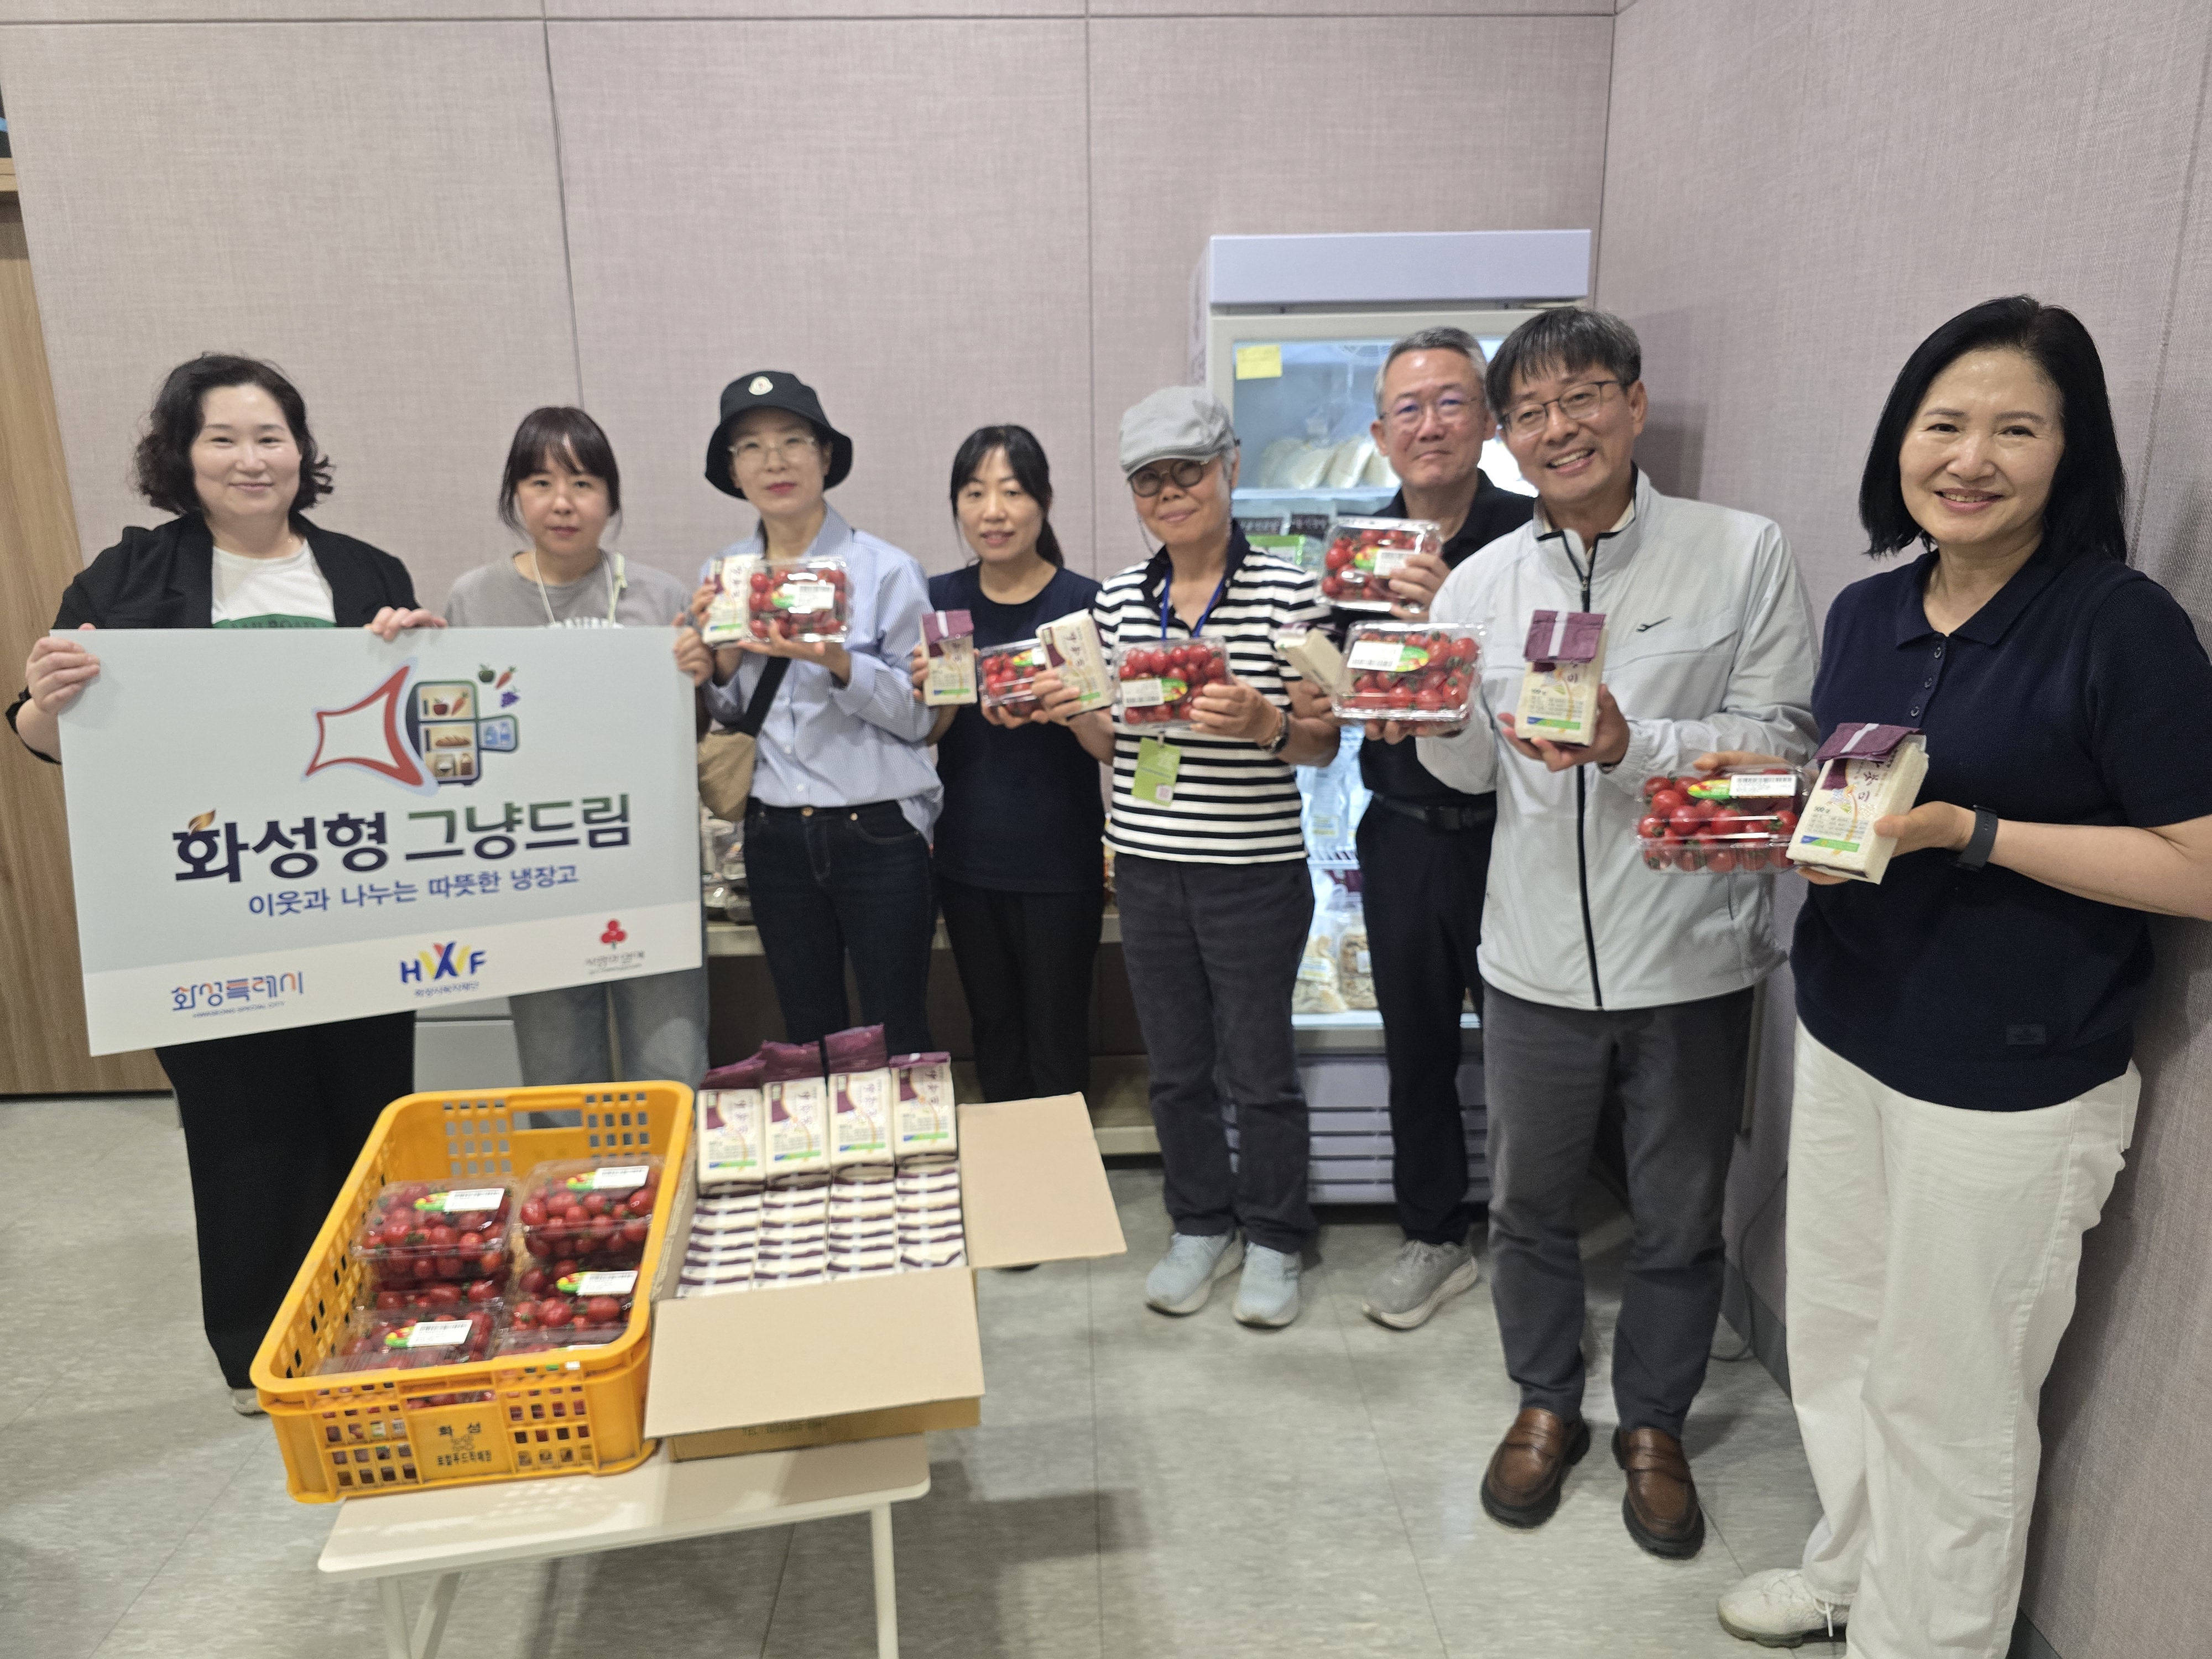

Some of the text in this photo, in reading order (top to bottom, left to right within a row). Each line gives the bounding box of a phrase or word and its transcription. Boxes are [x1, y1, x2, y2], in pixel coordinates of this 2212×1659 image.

[173, 794, 629, 883] 화성형 그냥드림
[249, 864, 580, 917] 이웃과 나누는 따뜻한 냉장고
[171, 972, 304, 1010] 화성특례시
